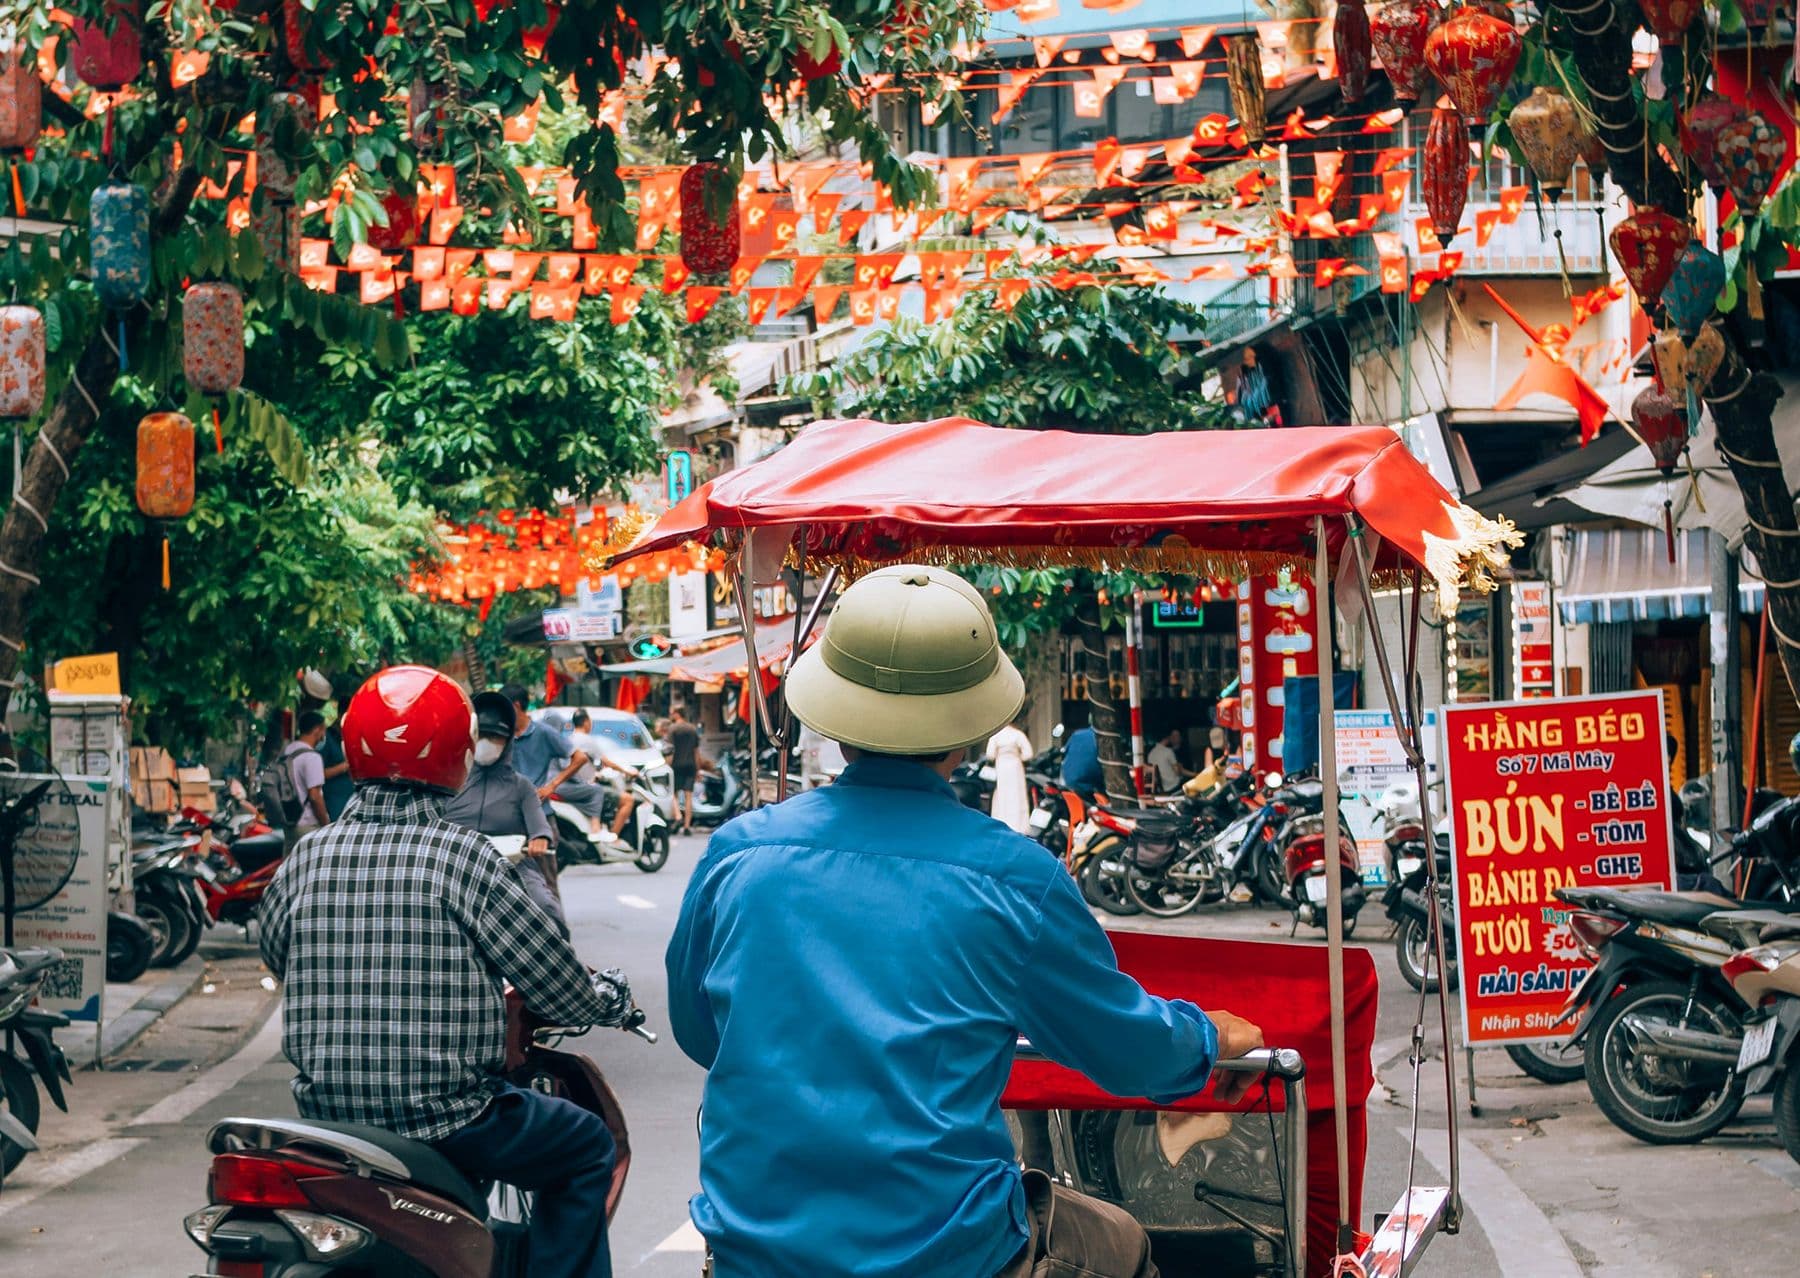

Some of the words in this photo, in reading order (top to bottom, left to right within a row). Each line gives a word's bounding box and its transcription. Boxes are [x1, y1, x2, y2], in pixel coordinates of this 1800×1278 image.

[1575, 708, 1646, 745] BÉO
[1498, 754, 1524, 775] Số
[1526, 754, 1538, 773] 7
[1542, 753, 1571, 772] Mã
[60, 793, 103, 807] DEAL
[1463, 780, 1566, 857] BÚN
[1592, 818, 1646, 846] TÔM
[1595, 853, 1643, 880] GHẸ
[1467, 862, 1538, 907] BÁNH
[1543, 866, 1578, 902] ĐA
[36, 929, 63, 941] Flight
[65, 930, 96, 941] tickets
[1551, 934, 1578, 950] 50
[1478, 965, 1518, 997] HẢI
[1519, 963, 1567, 993] SẢN
[1480, 1015, 1521, 1032] Nhận
[378, 1187, 457, 1224] VISION
